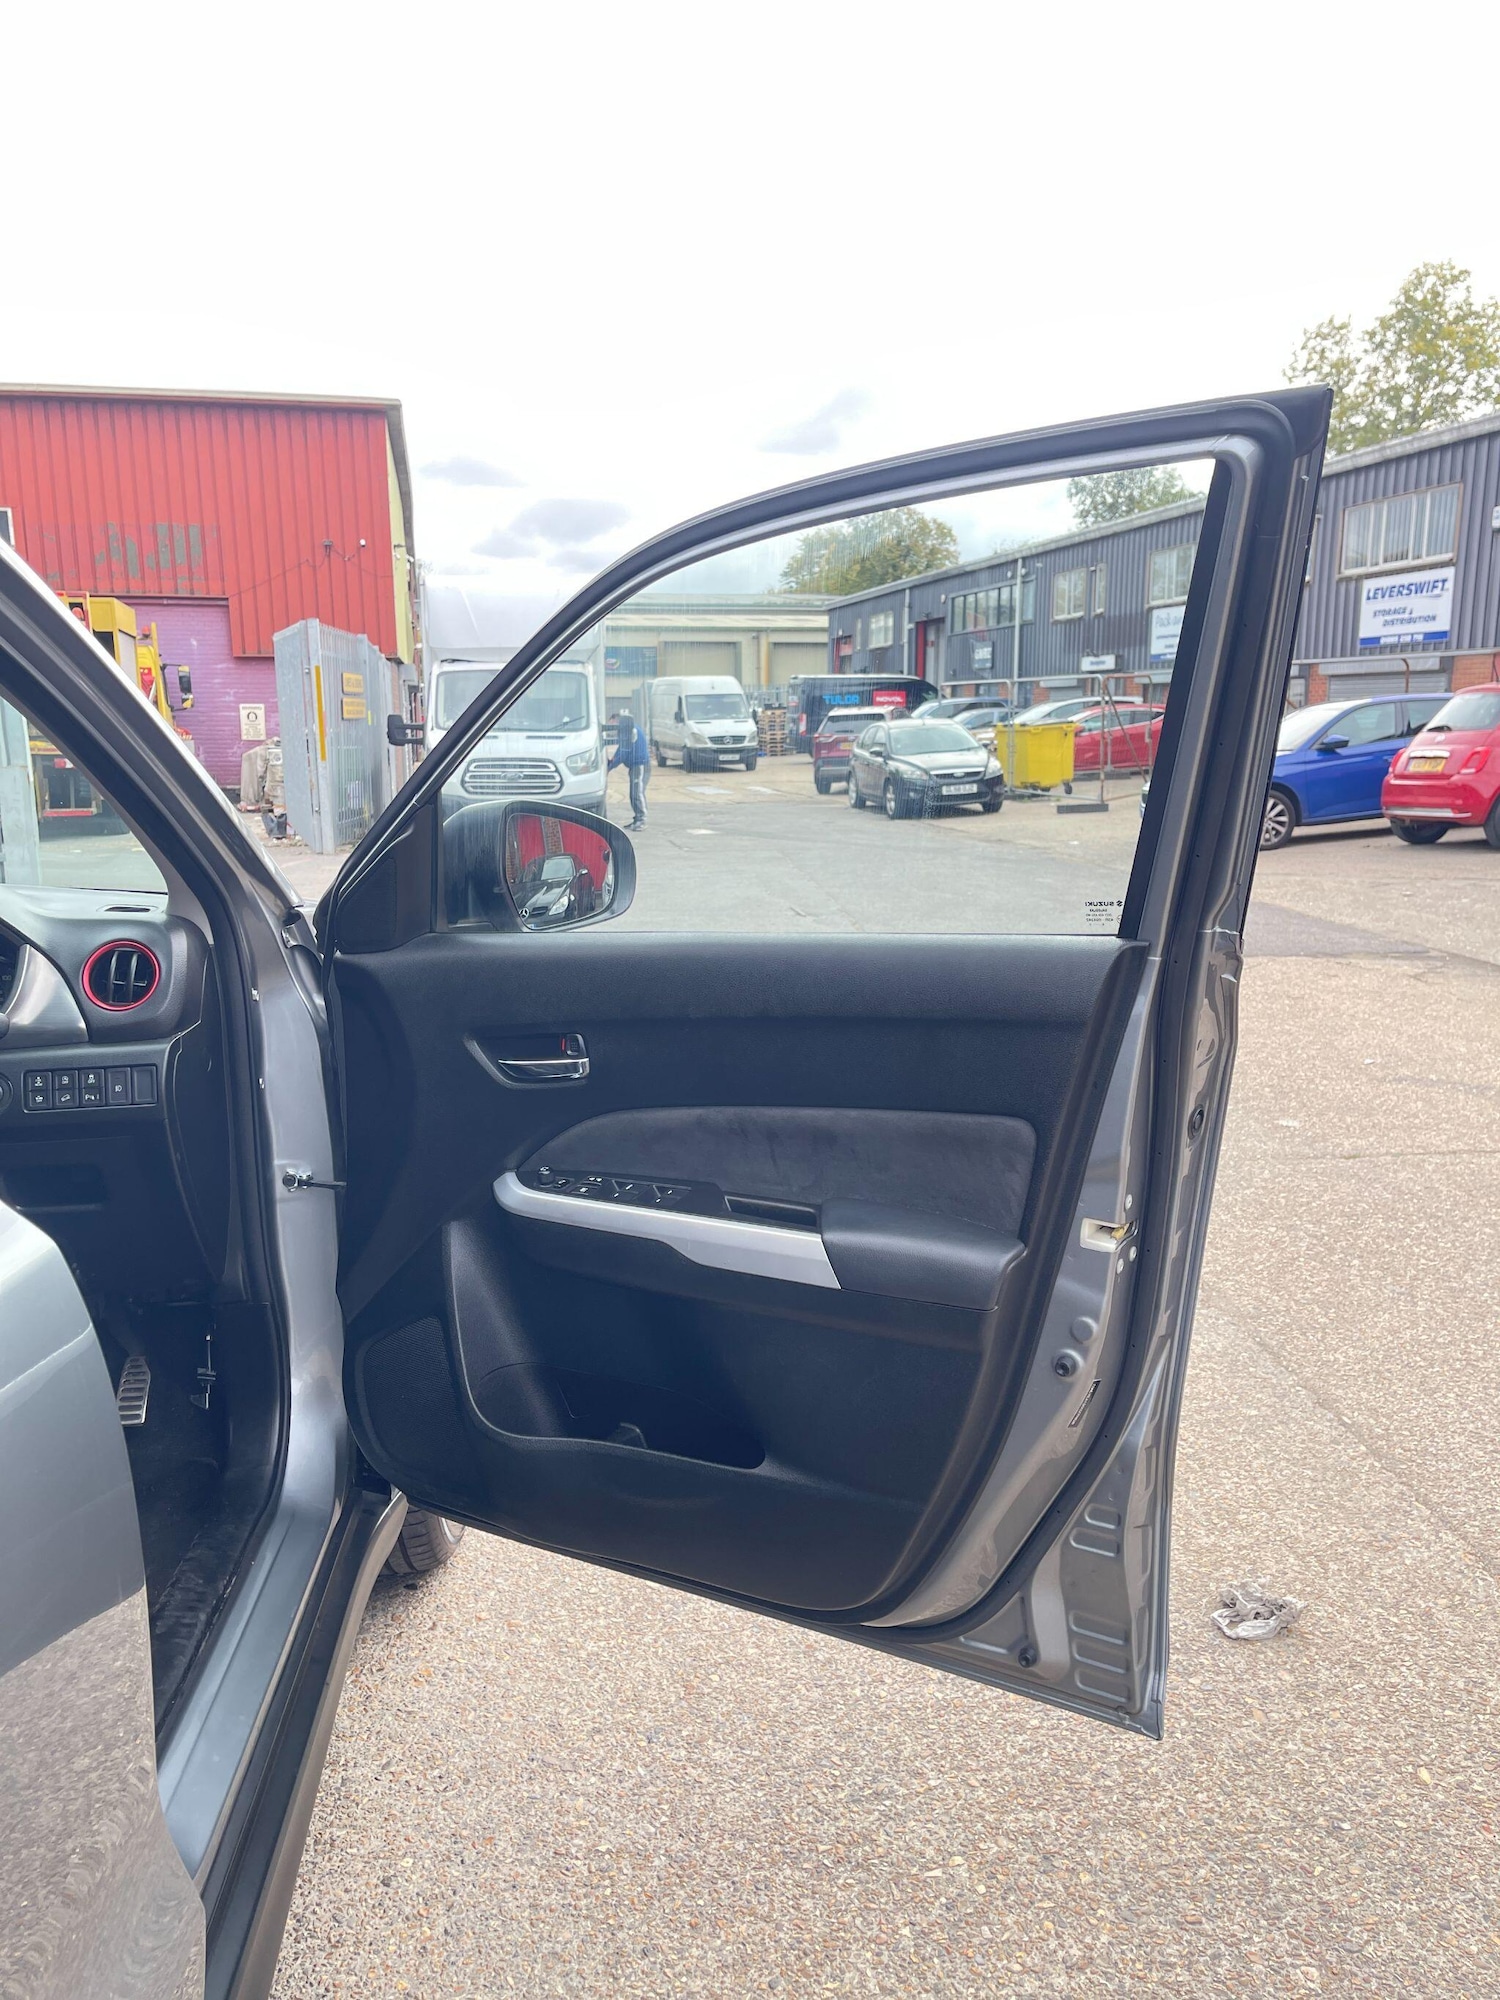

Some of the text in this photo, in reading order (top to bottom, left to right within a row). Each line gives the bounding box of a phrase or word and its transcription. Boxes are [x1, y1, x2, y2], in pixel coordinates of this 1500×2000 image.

[1366, 579, 1448, 600] LEVERSWIFT
[1373, 607, 1407, 617] STORAGE
[1383, 615, 1437, 627] DISTRIBUTION
